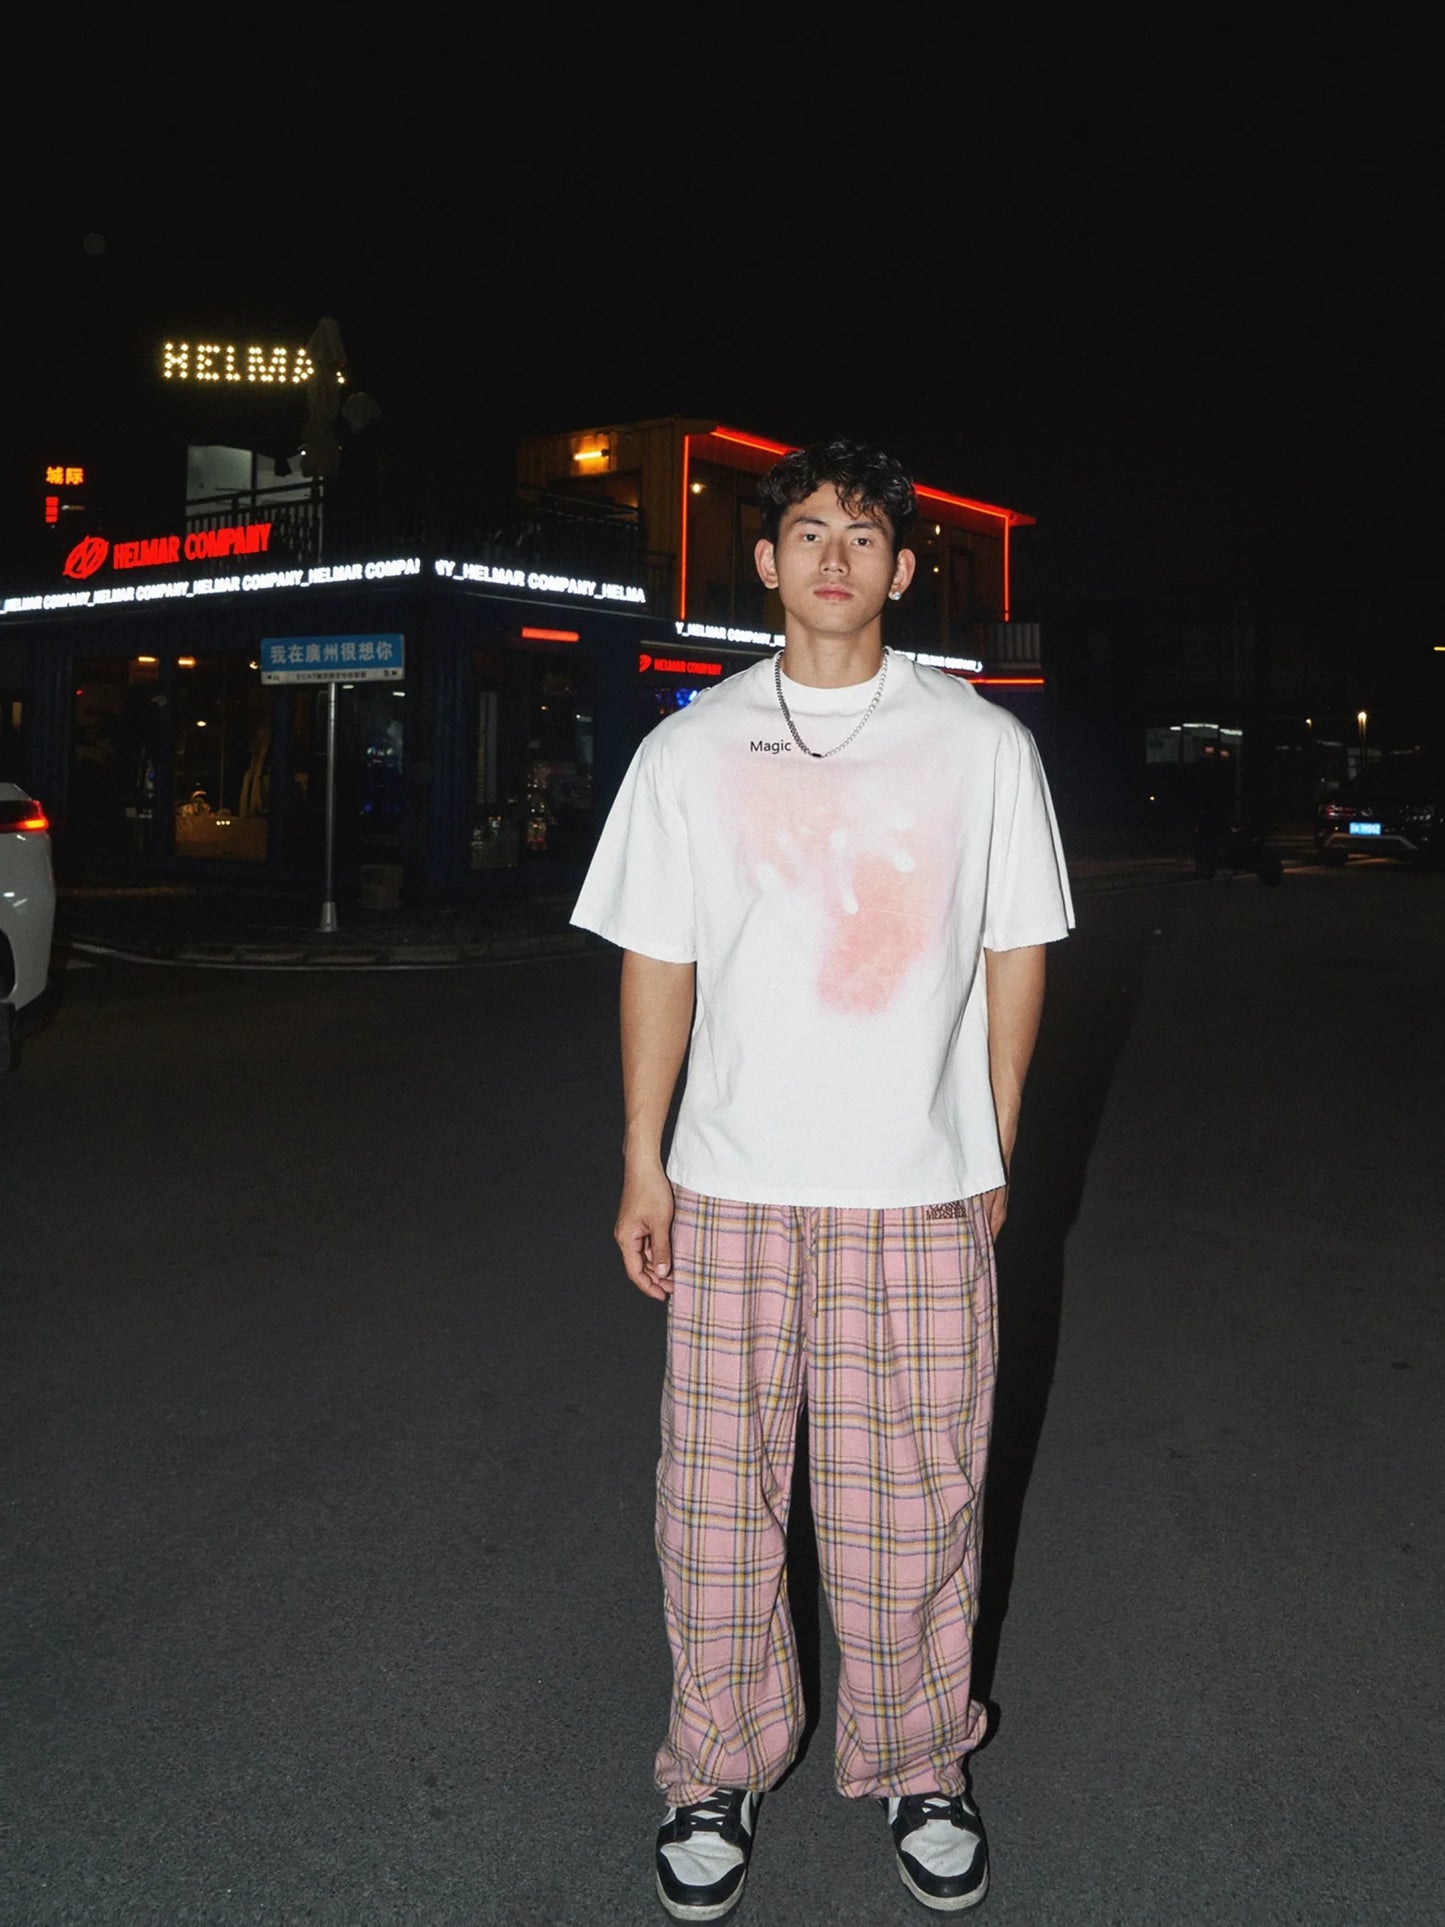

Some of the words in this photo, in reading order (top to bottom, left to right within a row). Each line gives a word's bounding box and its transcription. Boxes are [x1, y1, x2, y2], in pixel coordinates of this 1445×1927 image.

[113, 536, 181, 570] HELMAR
[184, 523, 272, 561] COMPANY
[270, 641, 393, 664] 我在廣州很想你
[750, 739, 791, 755] Magic
